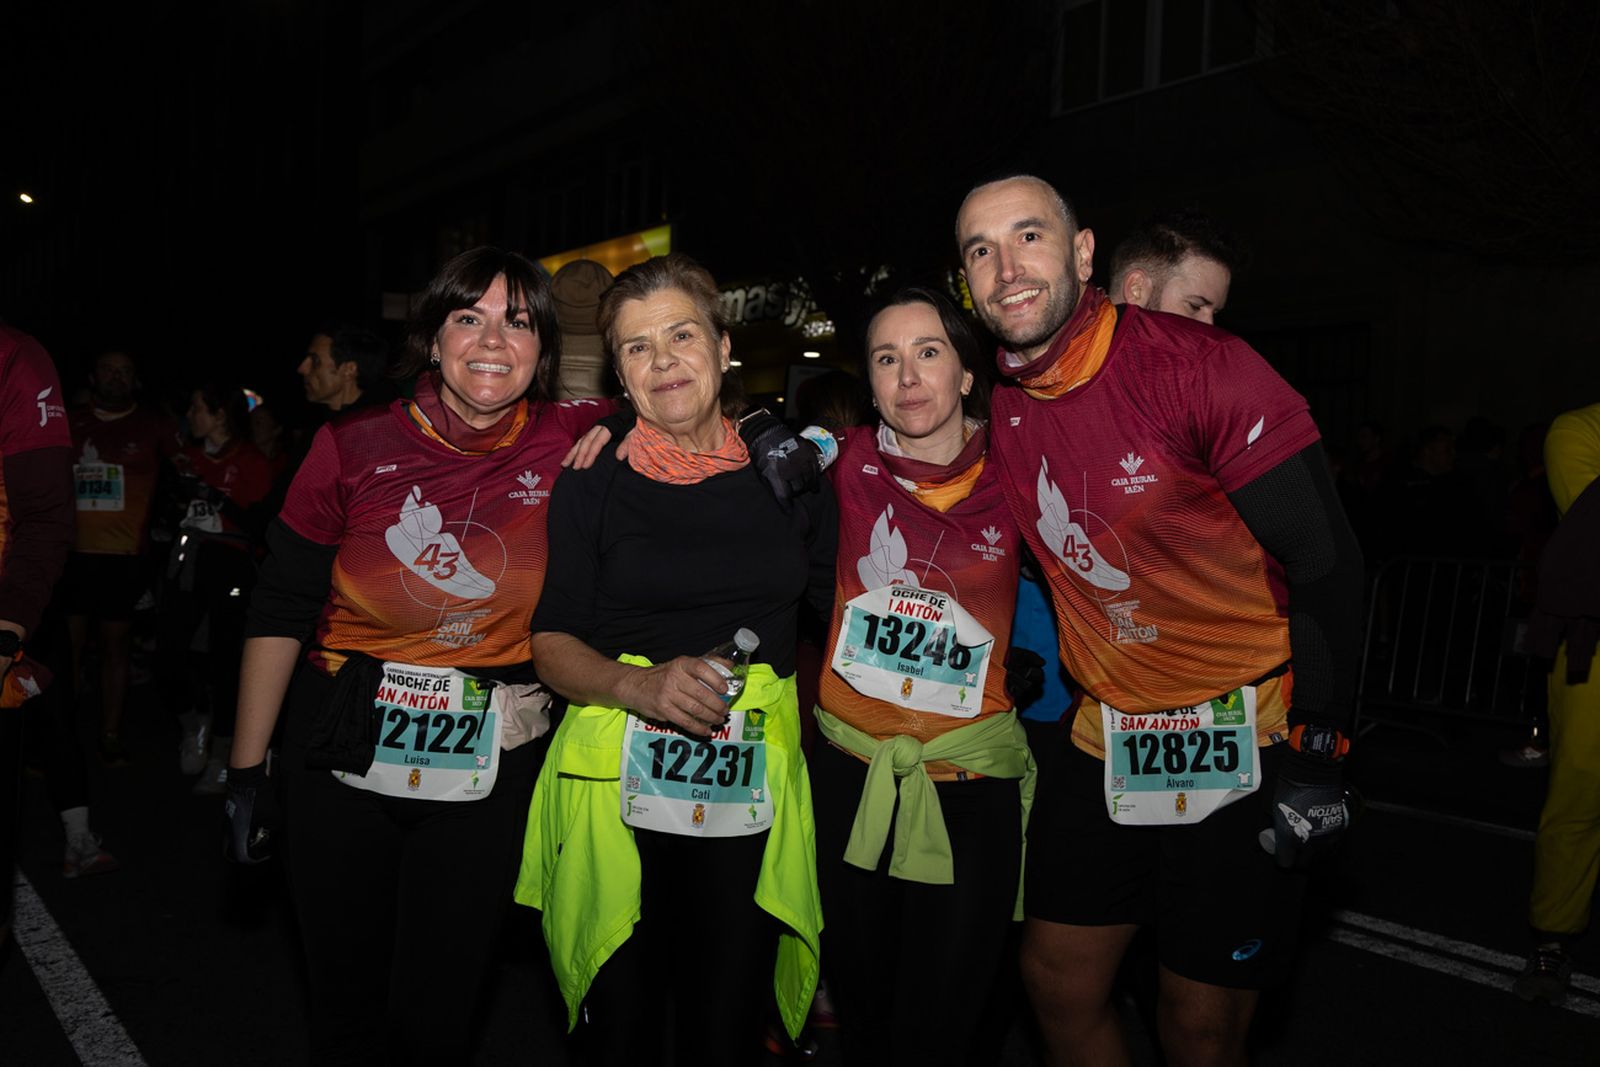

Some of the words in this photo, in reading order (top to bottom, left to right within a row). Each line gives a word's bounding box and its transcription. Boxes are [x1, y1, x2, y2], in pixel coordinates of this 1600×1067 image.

[413, 543, 460, 580] 43
[1062, 535, 1094, 573] 43
[892, 590, 927, 602] OCHE
[929, 595, 947, 610] DE
[894, 600, 943, 622] ANTÓN
[863, 613, 971, 671] 13248
[897, 661, 924, 676] Isabel
[387, 673, 431, 692] NOCHE
[432, 679, 451, 693] DE
[375, 686, 398, 704] AN
[397, 691, 450, 711] ANTÓN
[375, 706, 479, 754] 12122
[1120, 717, 1147, 732] SAN
[1148, 715, 1200, 732] ANTÓN
[404, 754, 431, 766] Luisa
[648, 737, 755, 787] 12231
[1123, 730, 1239, 775] 12825
[1166, 776, 1194, 788] Álvaro
[691, 788, 710, 800] Cati
